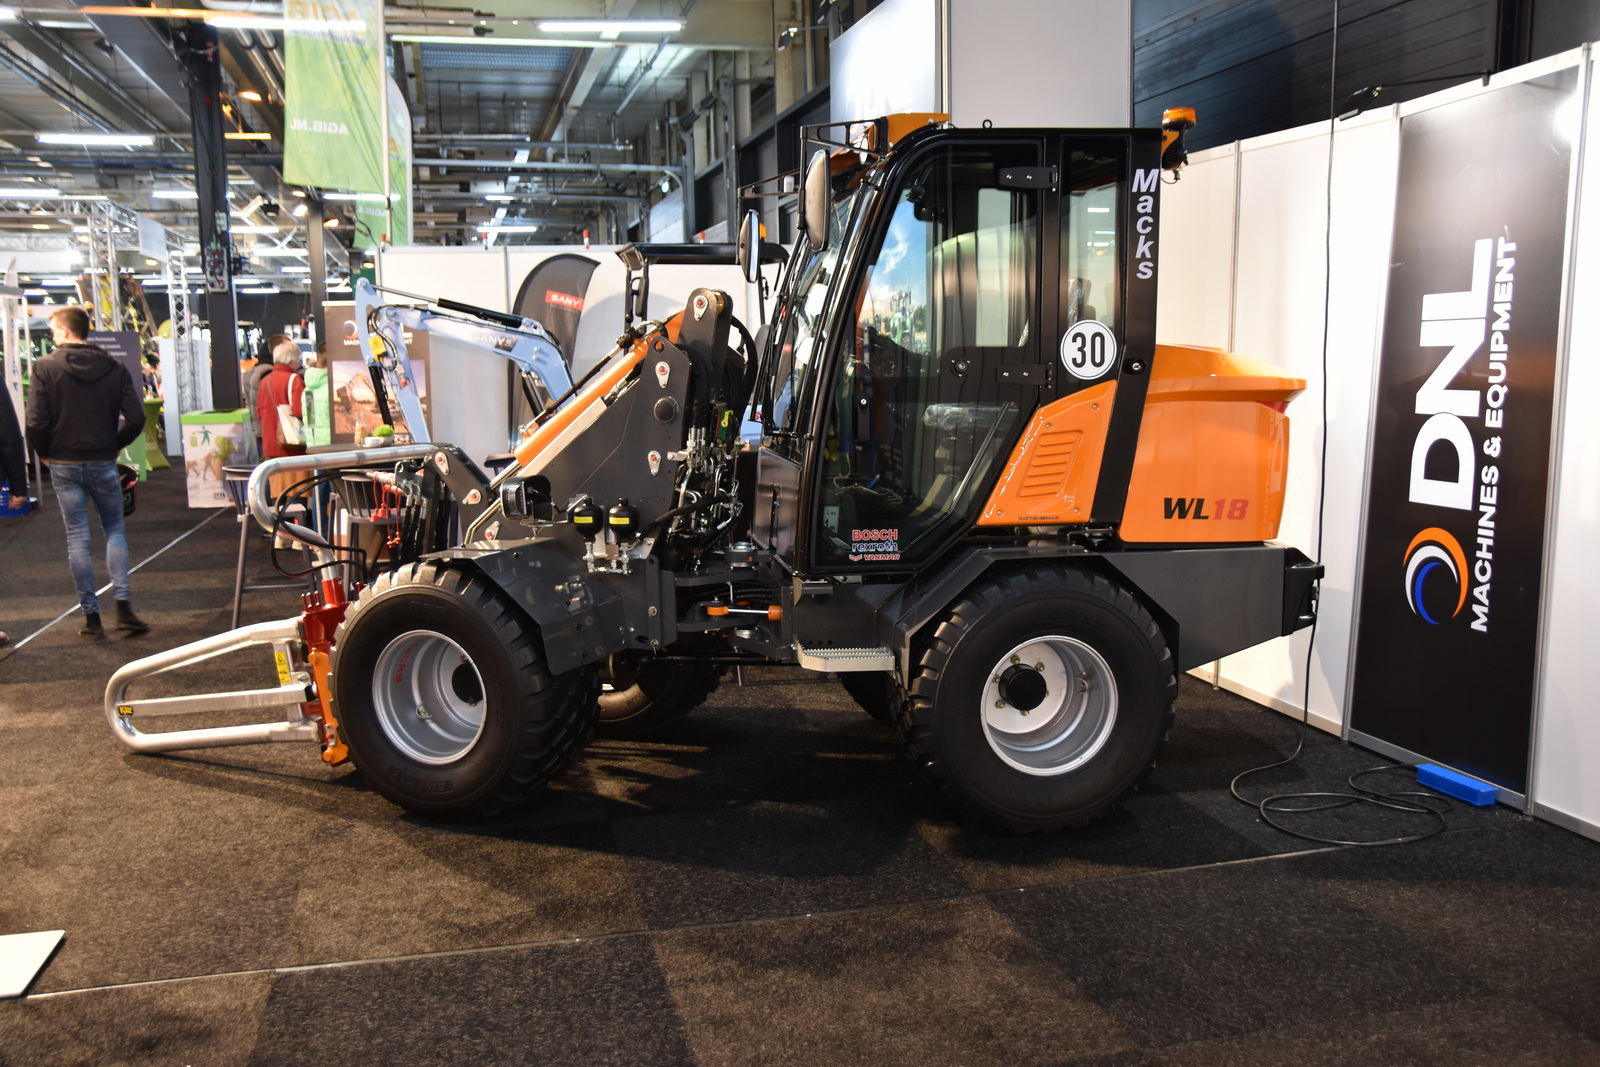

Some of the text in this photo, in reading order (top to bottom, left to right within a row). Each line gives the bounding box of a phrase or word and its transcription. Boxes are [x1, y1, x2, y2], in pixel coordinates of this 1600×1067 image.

[1132, 168, 1160, 279] Macks
[551, 293, 581, 307] SANY
[1072, 332, 1105, 368] 30
[1408, 238, 1493, 511] DNL
[1470, 237, 1517, 633] MACHINES & EQUIPMENT
[1163, 497, 1249, 521] WL18
[851, 529, 899, 541] BOSCH
[851, 540, 899, 552] rexroth
[863, 553, 901, 561] YANMAR
